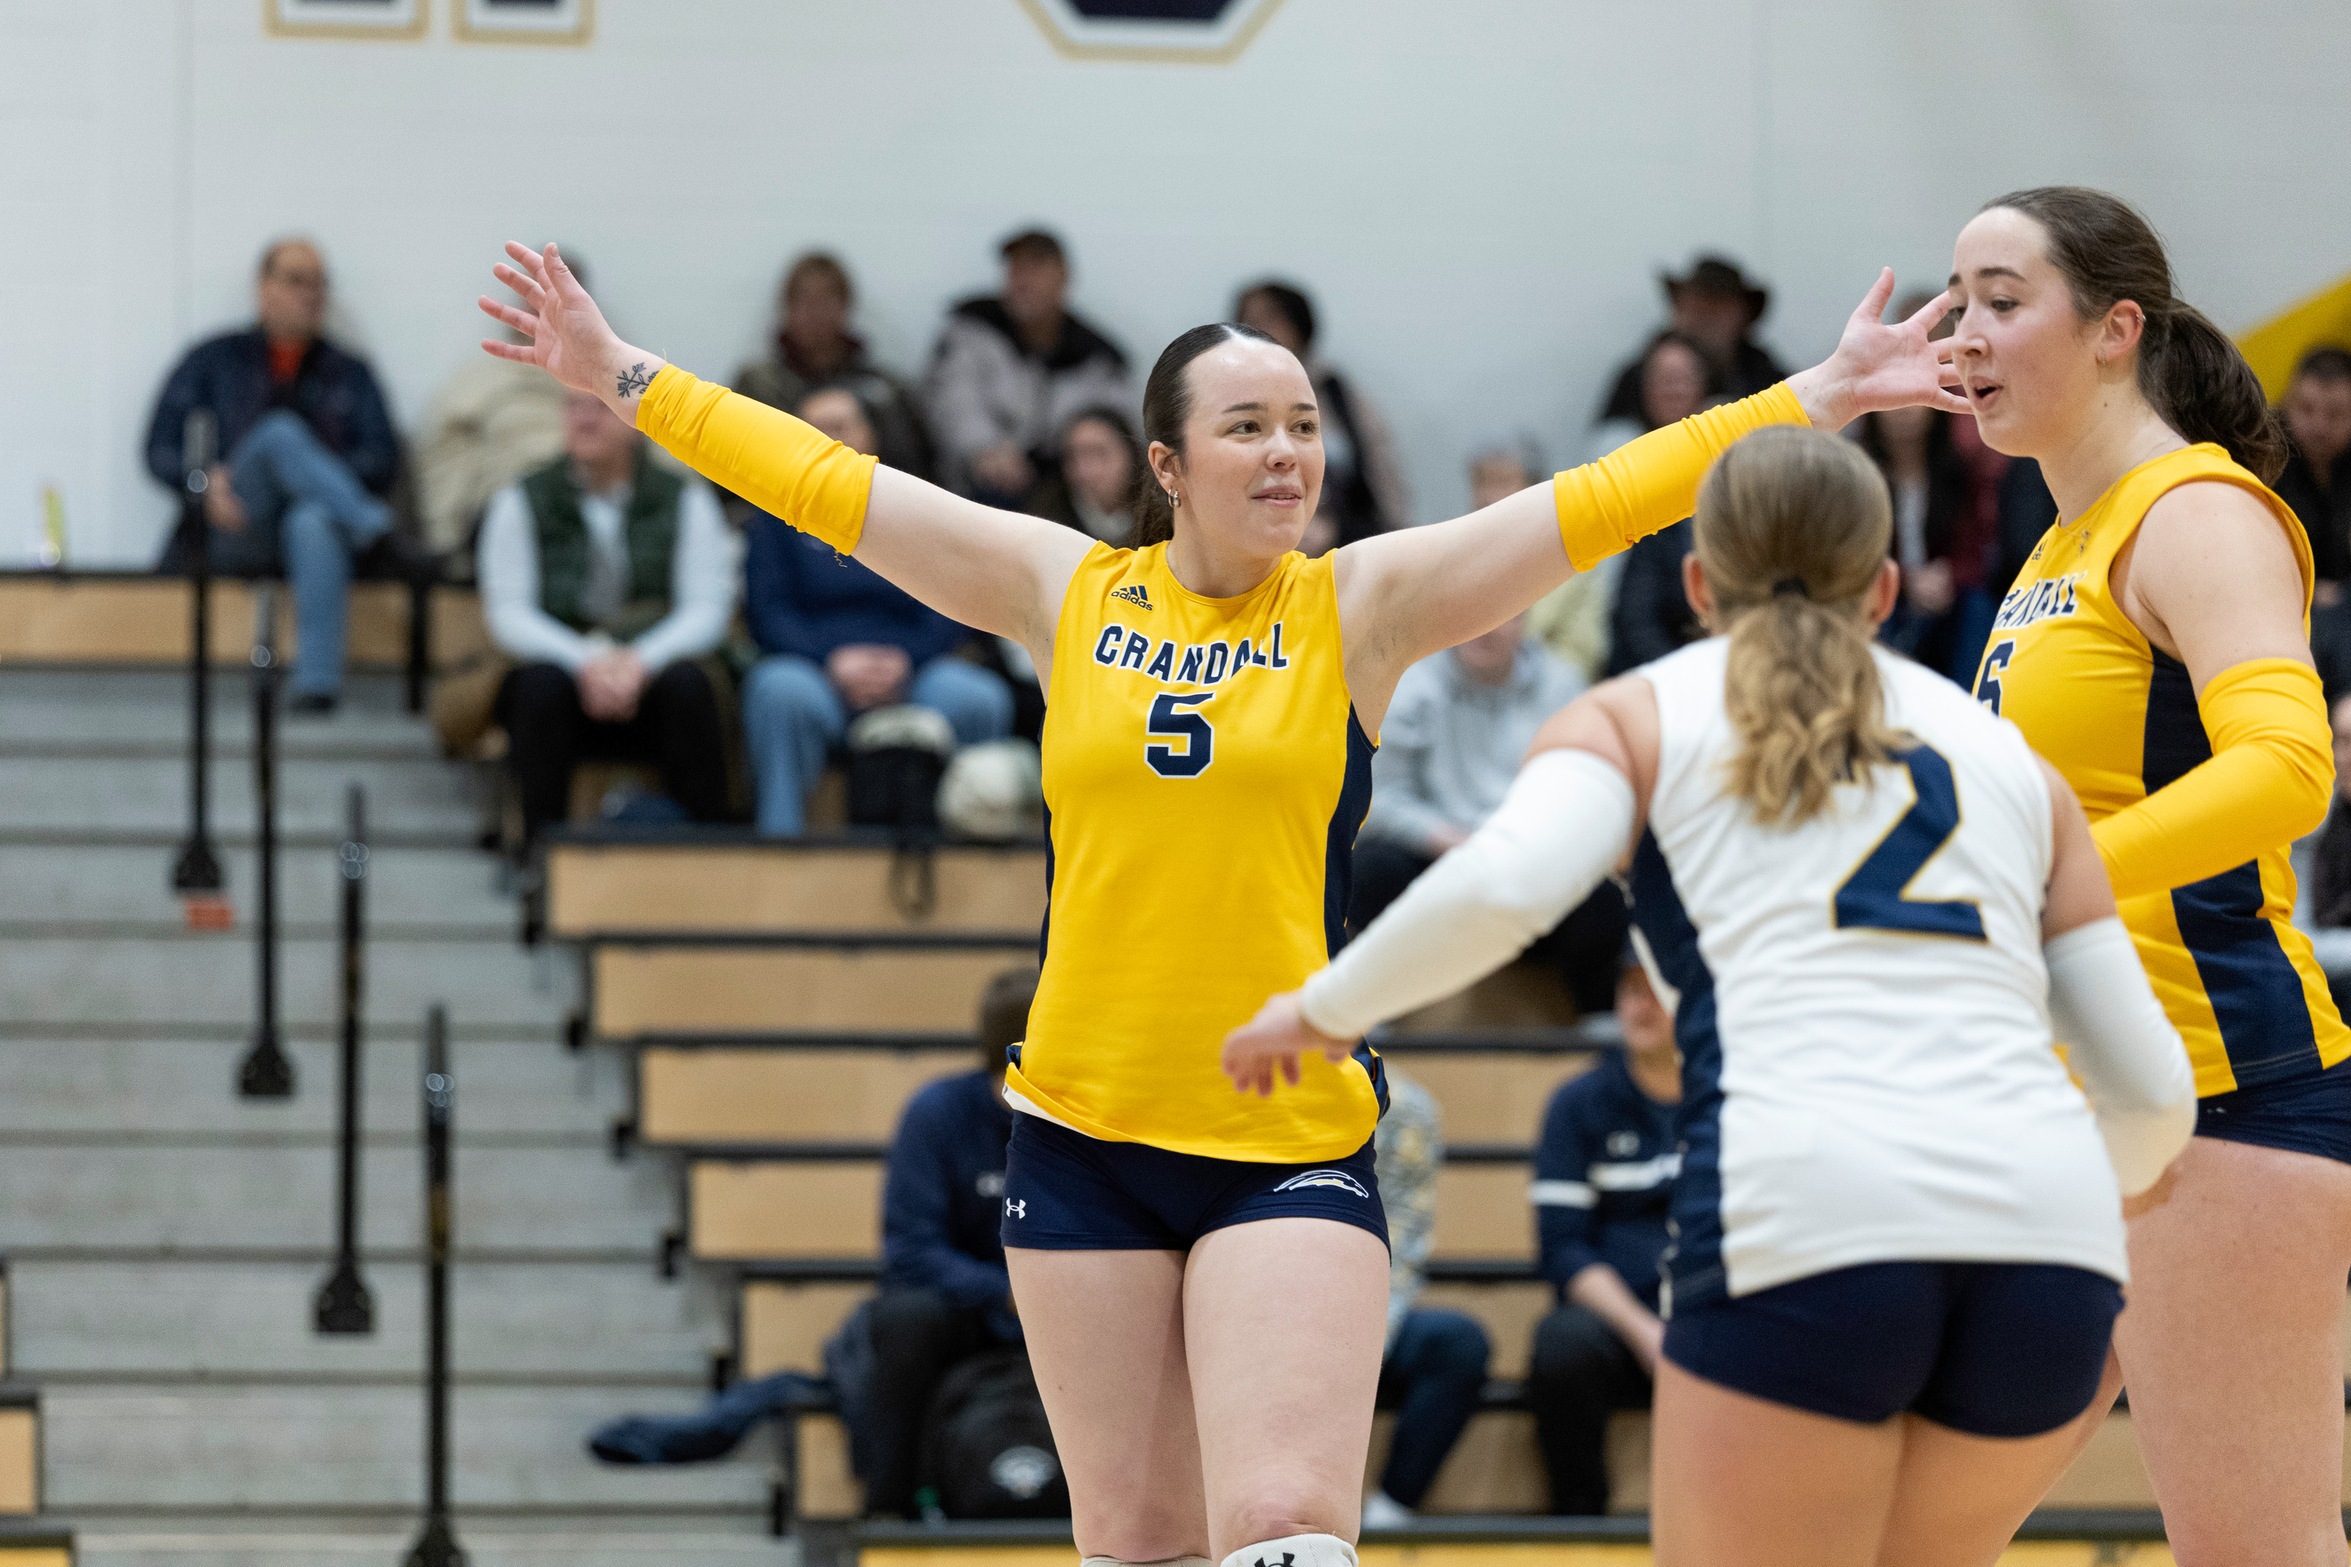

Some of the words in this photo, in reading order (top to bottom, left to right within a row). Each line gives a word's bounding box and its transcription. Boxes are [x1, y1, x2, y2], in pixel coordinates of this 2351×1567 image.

[1111, 591, 1153, 611] adidas
[1093, 621, 1290, 686] CRANDALL
[1976, 637, 2016, 718] 6
[1144, 690, 1216, 779] 5
[1829, 736, 1992, 945] 2
